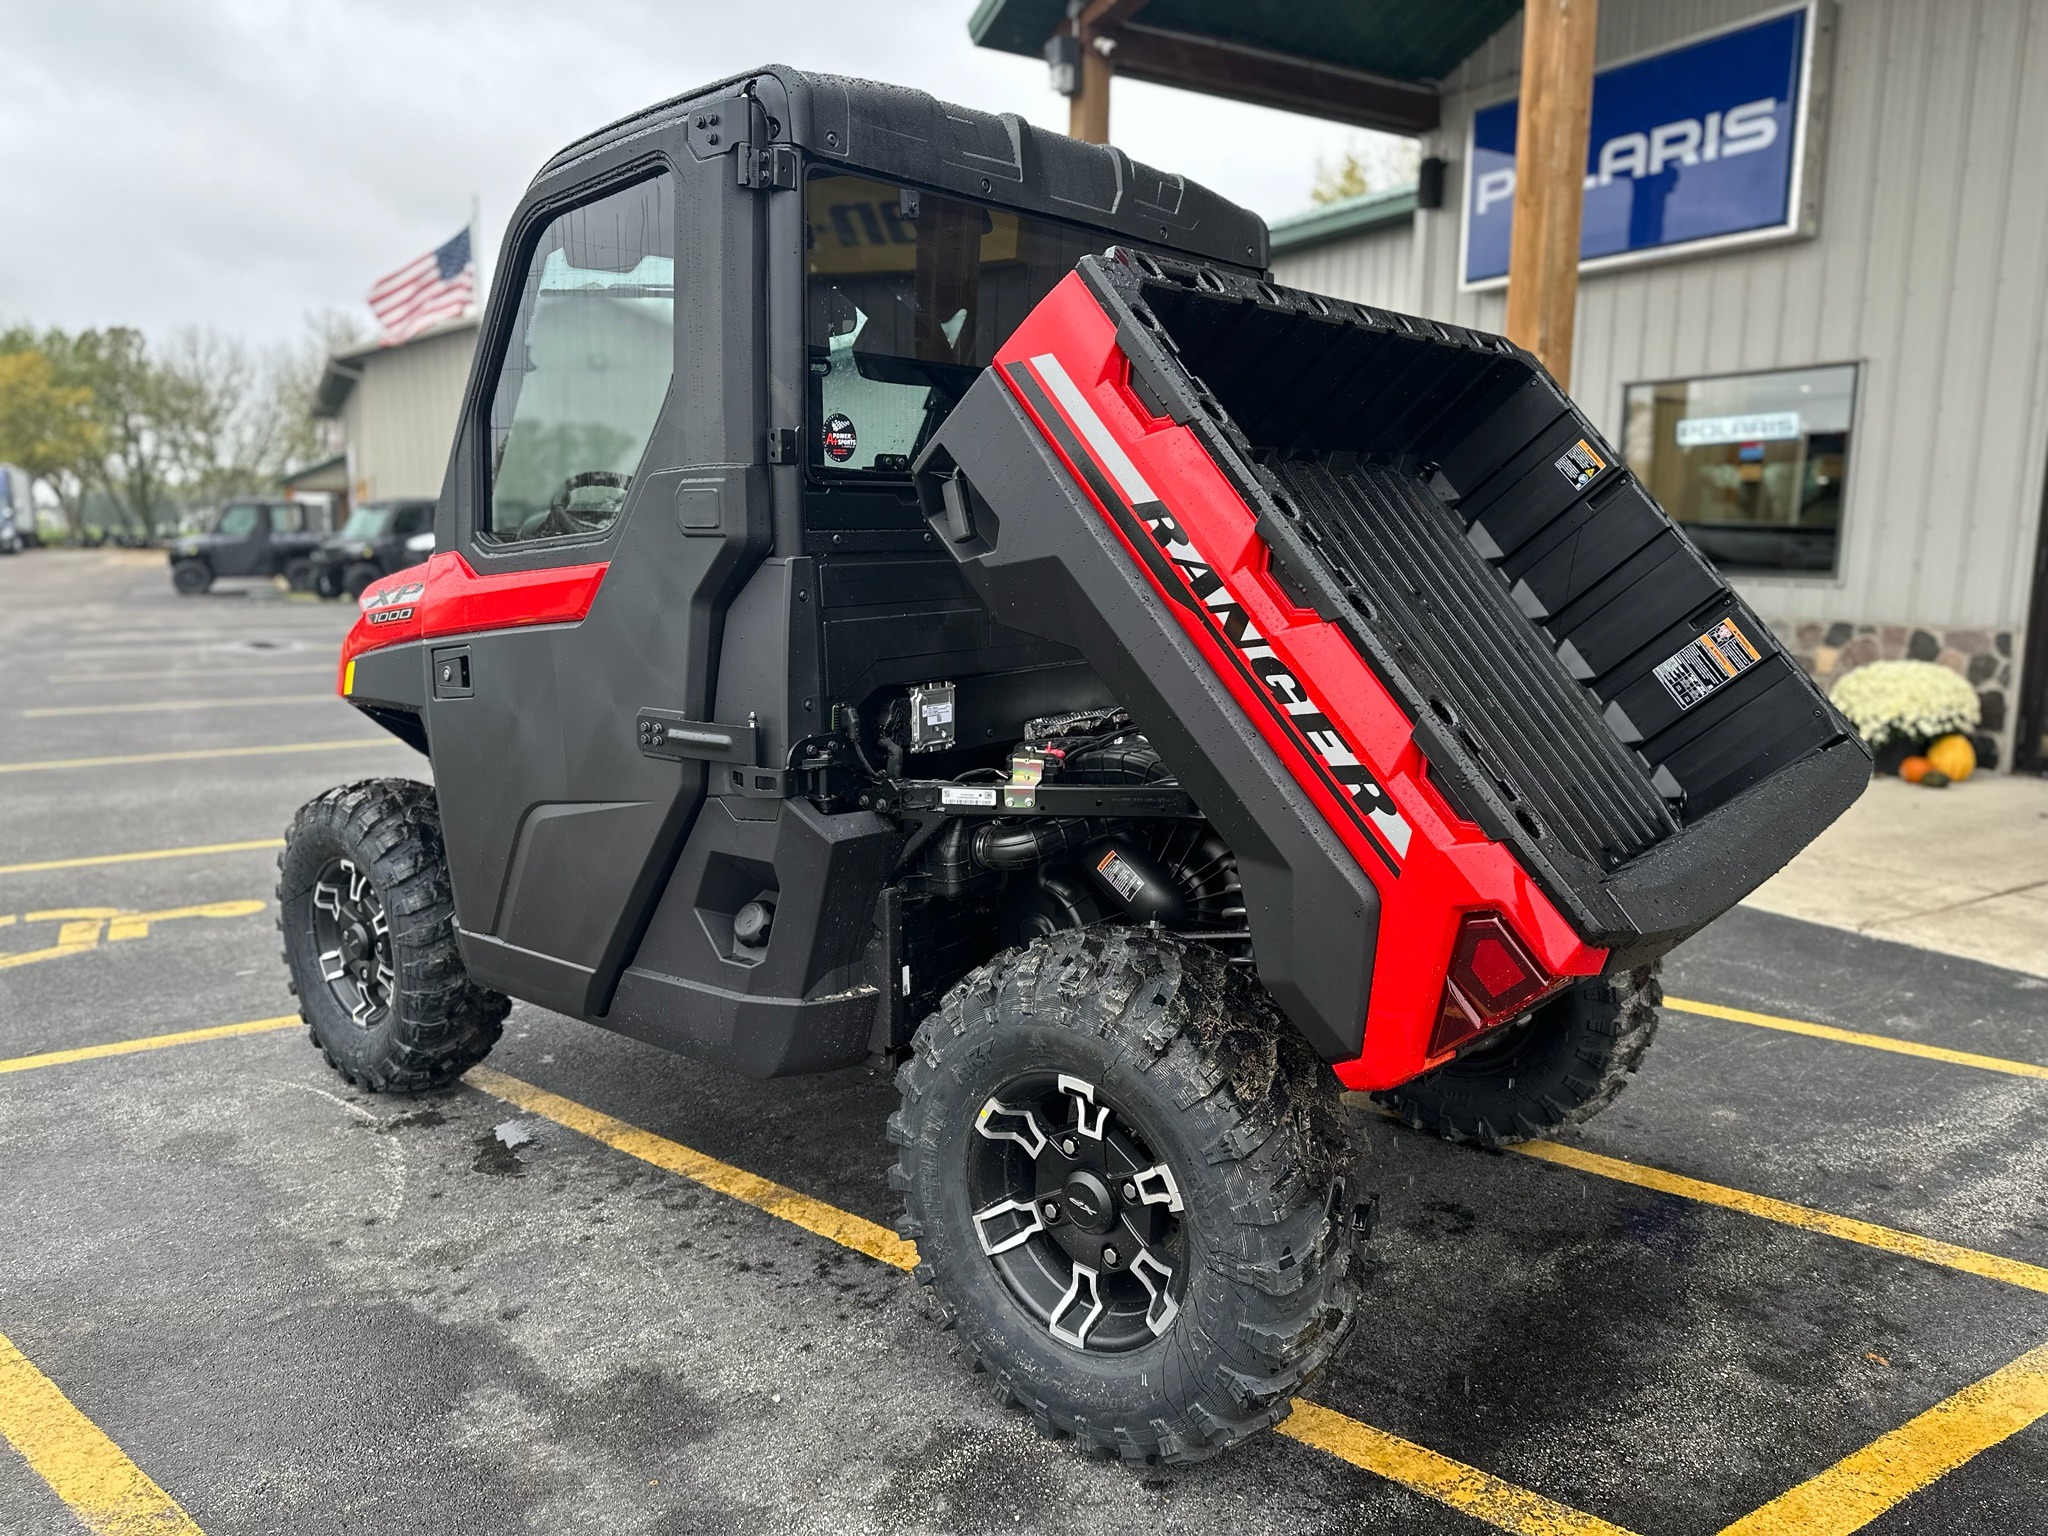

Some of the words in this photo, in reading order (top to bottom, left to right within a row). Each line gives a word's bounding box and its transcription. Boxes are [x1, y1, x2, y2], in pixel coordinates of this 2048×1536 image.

[1475, 97, 1779, 216] PARIS
[366, 582, 424, 609] XP
[373, 608, 413, 624] 1000
[1131, 499, 1397, 817] RANGER
